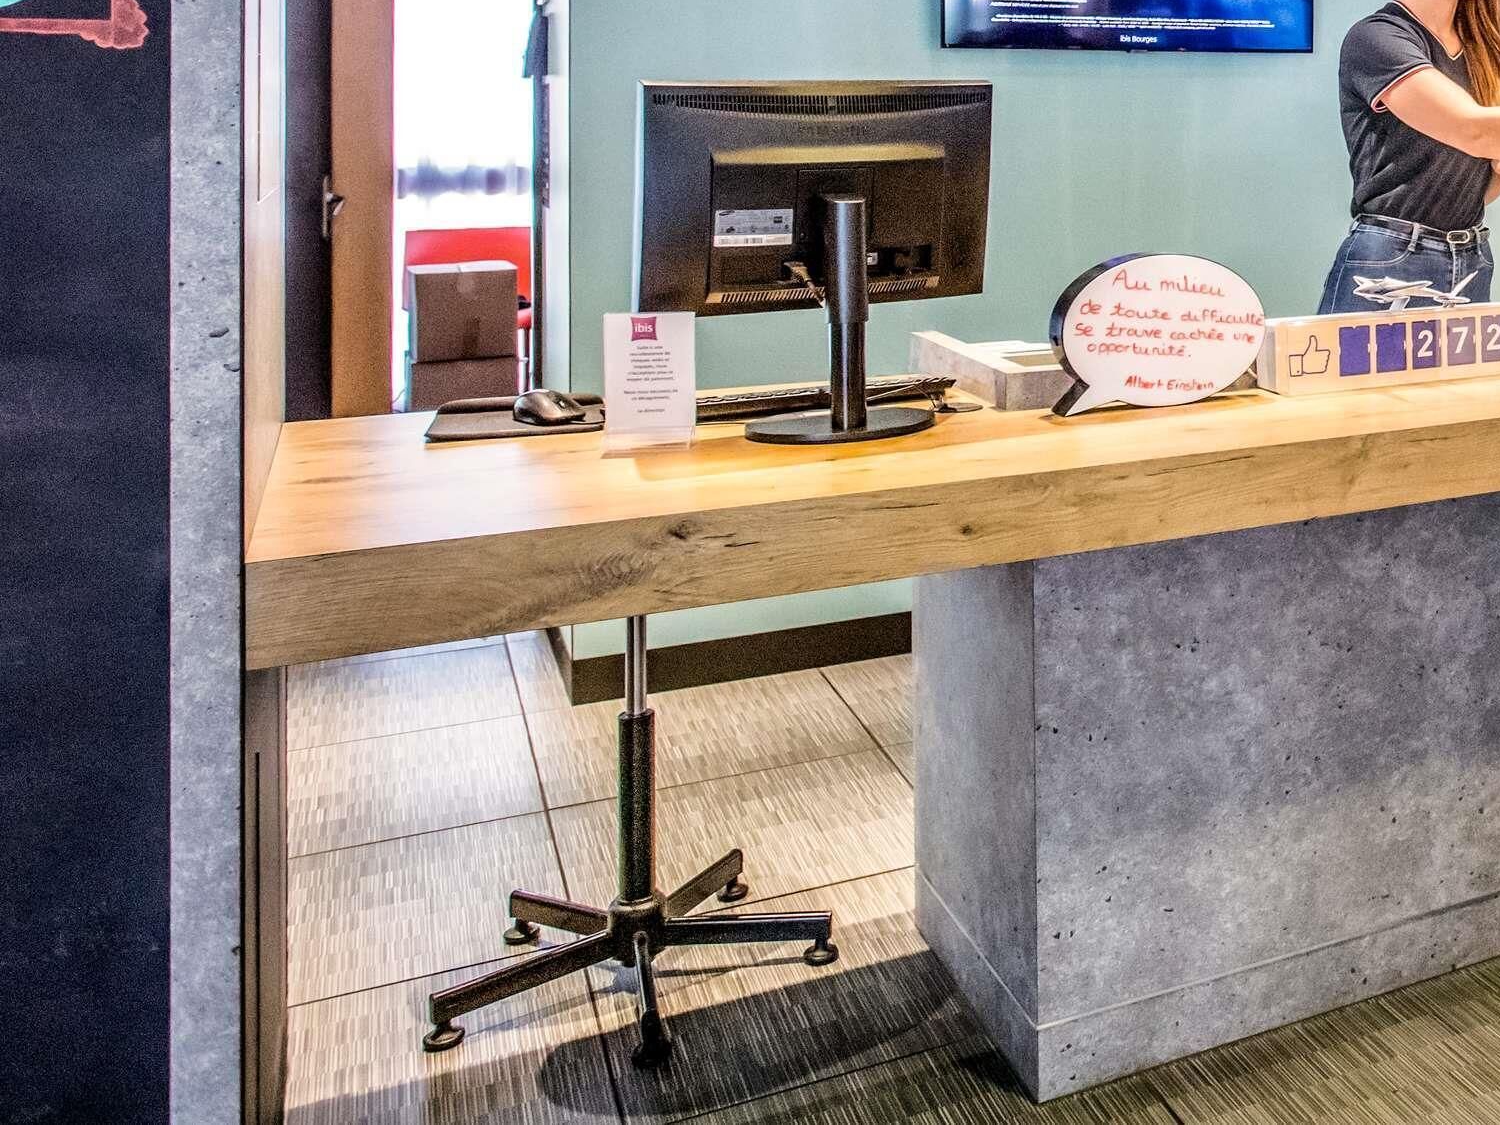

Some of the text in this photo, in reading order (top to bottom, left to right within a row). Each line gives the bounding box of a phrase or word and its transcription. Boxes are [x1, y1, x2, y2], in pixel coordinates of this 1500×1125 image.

[1131, 35, 1157, 44] Bourges
[1112, 268, 1225, 297] Au milieu
[1080, 299, 1102, 316] de
[1110, 302, 1171, 321] toute
[634, 323, 654, 333] ibis
[1105, 322, 1162, 338] trouve
[1169, 327, 1225, 342] cachée
[1233, 332, 1255, 344] une
[1087, 342, 1192, 359] opportunité.
[1124, 374, 1214, 391] Albert Einstein
